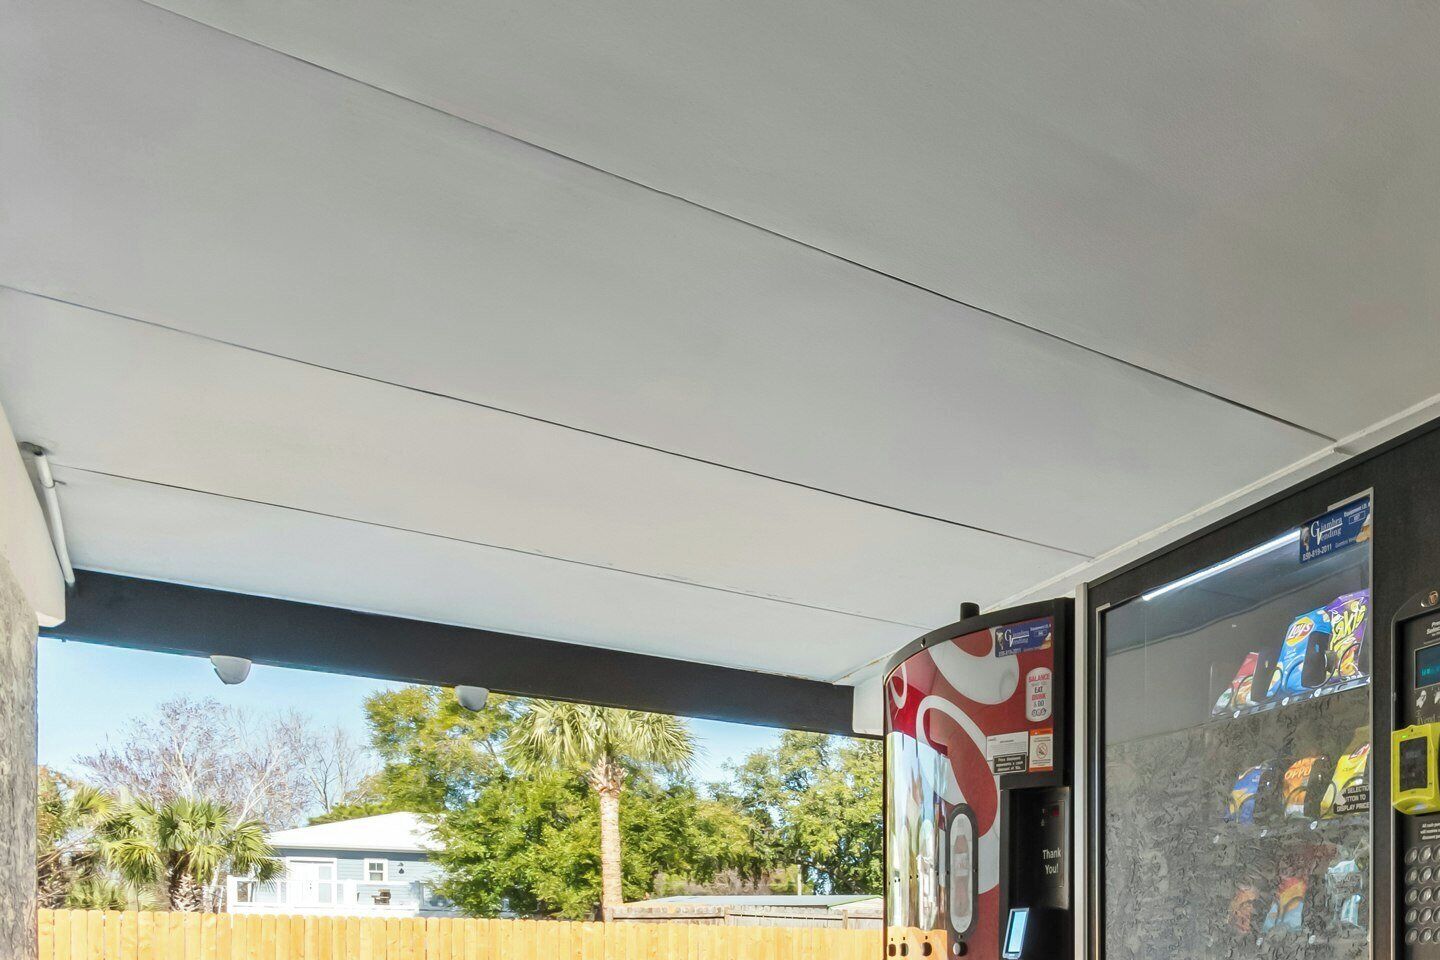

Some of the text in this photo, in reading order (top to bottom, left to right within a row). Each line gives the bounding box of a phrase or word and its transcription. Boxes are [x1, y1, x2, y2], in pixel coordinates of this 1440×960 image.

[1316, 525, 1343, 546] Vending
[1347, 785, 1370, 794] SELECTIO
[1336, 803, 1355, 812] DISPLAY
[1042, 847, 1062, 859] Thank
[1044, 863, 1059, 874] You!
